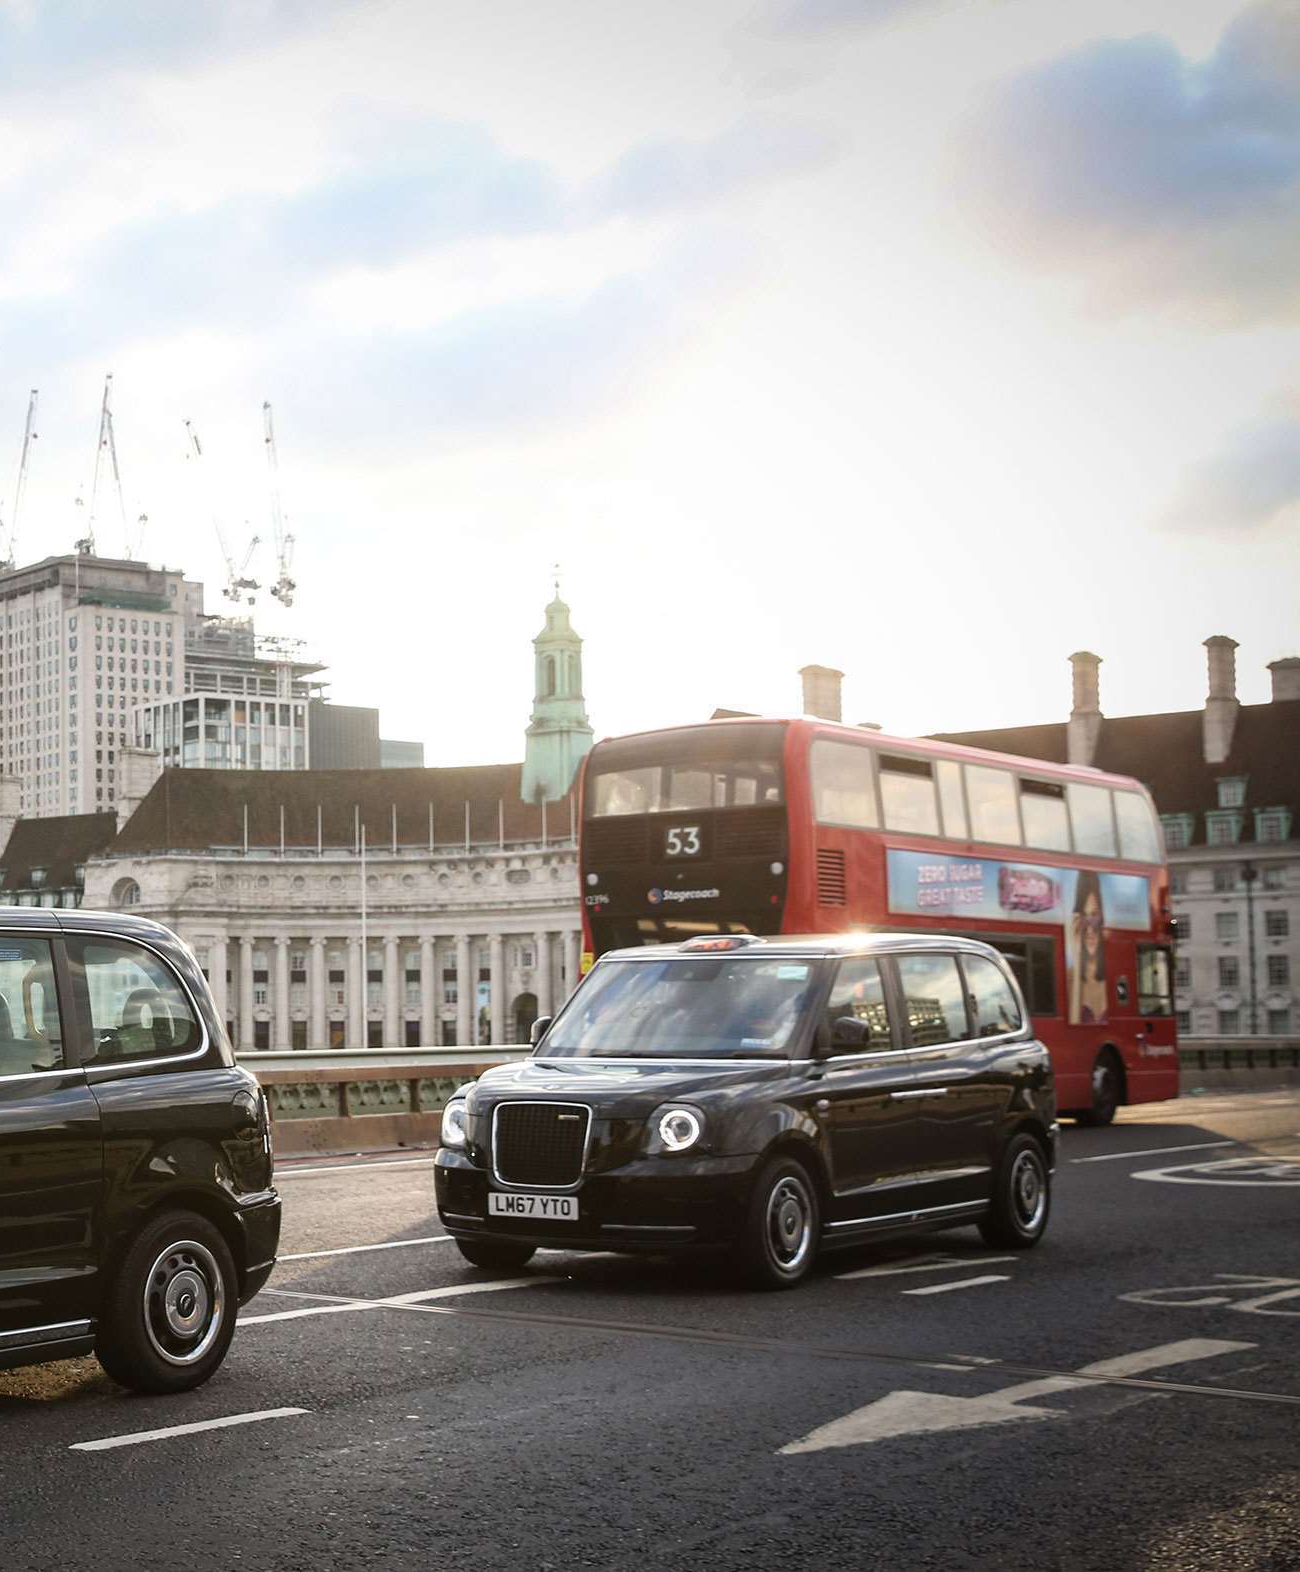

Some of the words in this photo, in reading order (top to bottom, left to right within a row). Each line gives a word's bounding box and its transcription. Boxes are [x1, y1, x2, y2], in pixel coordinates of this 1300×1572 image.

[666, 827, 700, 855] 53
[663, 889, 719, 902] Stagecoach
[495, 1196, 535, 1213] LM67
[540, 1198, 570, 1216] YTO
